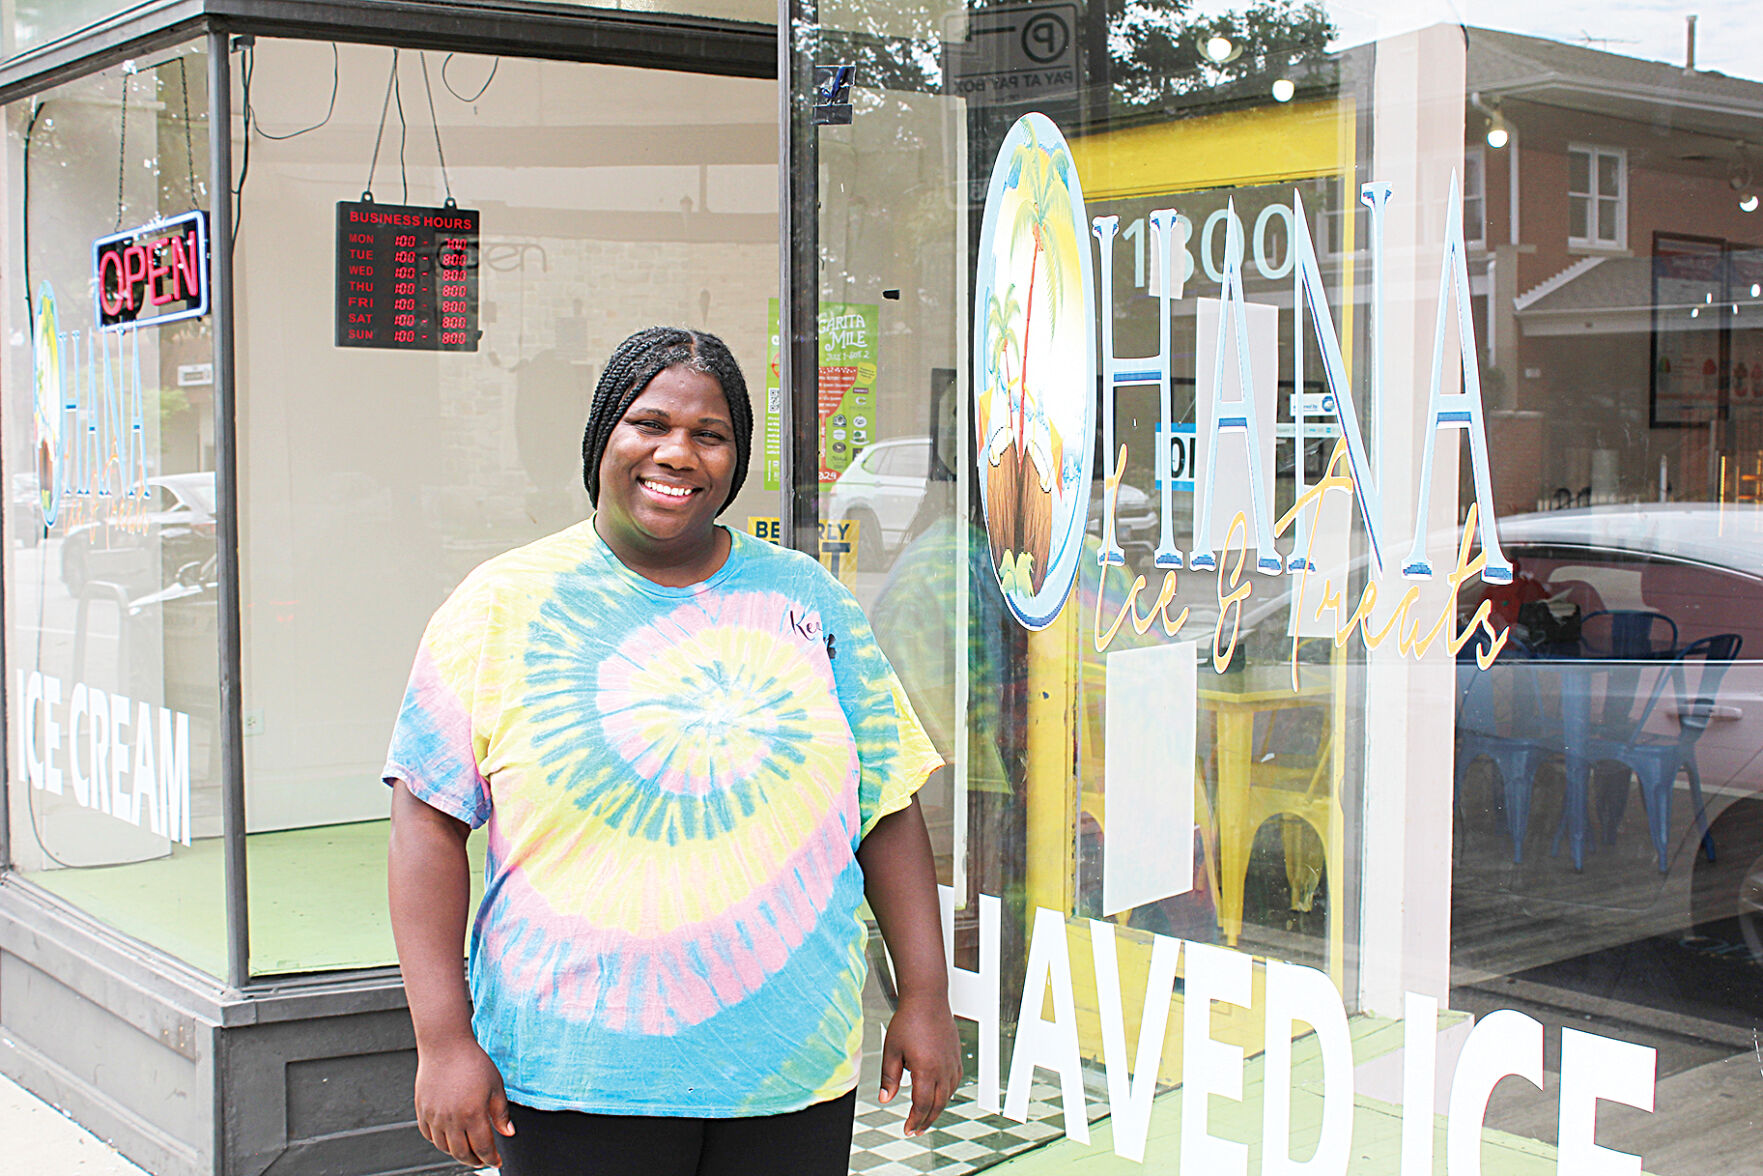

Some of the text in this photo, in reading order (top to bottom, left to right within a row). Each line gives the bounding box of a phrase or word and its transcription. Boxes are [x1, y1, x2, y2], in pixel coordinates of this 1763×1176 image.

[349, 211, 472, 230] BUSINESS HOURS
[348, 233, 374, 244] MON
[349, 249, 374, 260] TUE
[98, 230, 199, 316] OPEN
[348, 265, 374, 276] WED
[348, 281, 374, 292] THU
[347, 297, 374, 308] FRI
[348, 313, 373, 324] SAT
[348, 329, 374, 339] SUN
[825, 330, 868, 351] MILE
[818, 472, 837, 481] 024
[755, 521, 850, 540] BERLY
[1094, 433, 1511, 693] Ice & Treats
[16, 668, 192, 848] ICE CREAM
[880, 884, 1658, 1176] HAVED ICE
